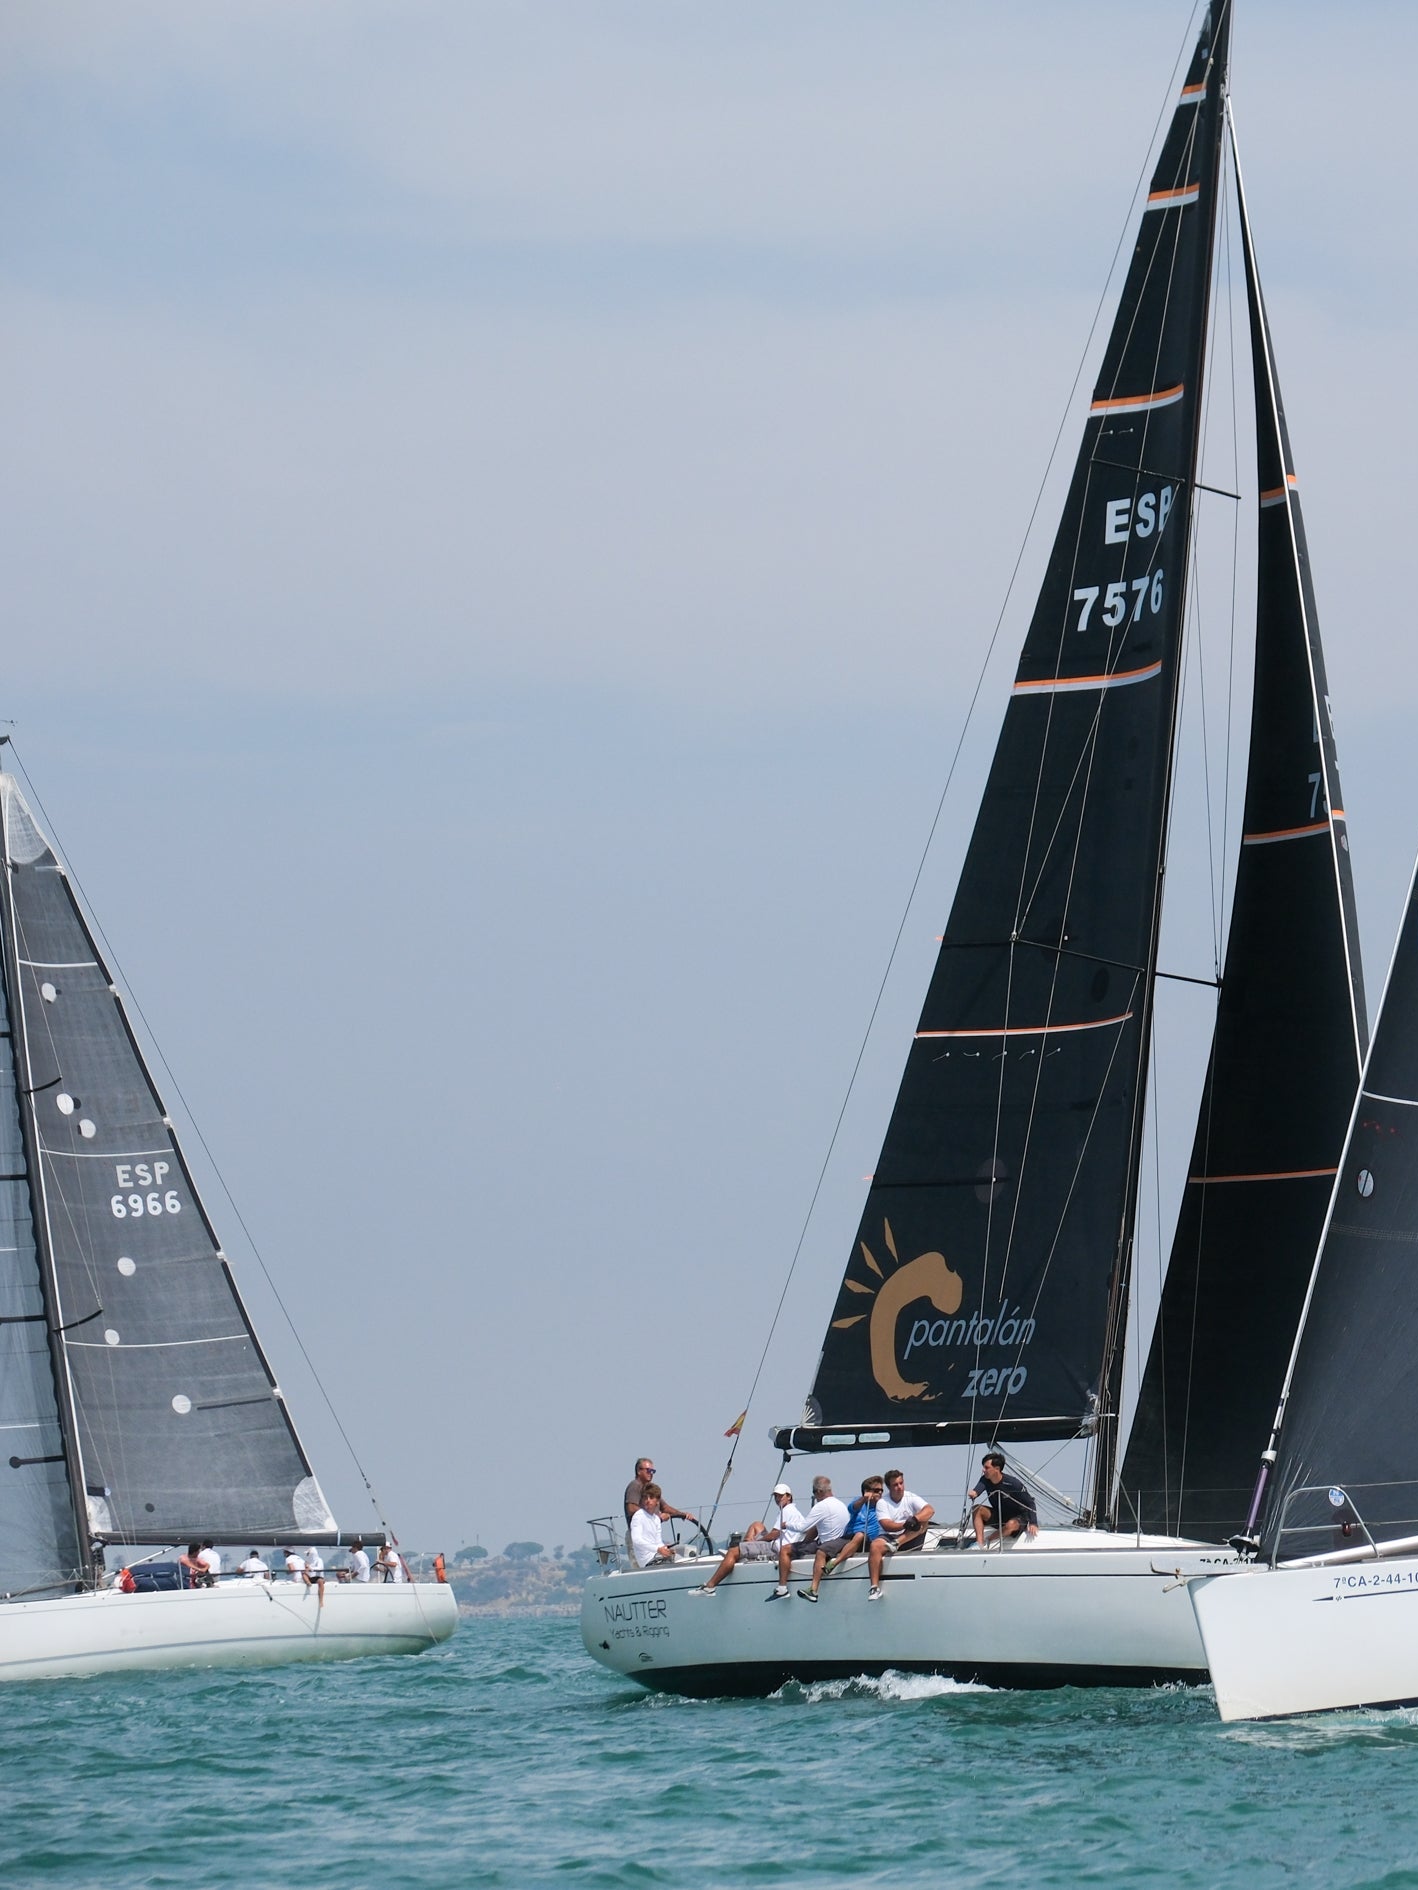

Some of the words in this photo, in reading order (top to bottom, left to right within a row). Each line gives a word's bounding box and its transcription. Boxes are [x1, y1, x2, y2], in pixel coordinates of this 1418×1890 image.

[1104, 485, 1172, 545] ESP
[1073, 568, 1165, 632] 7576
[115, 1161, 170, 1188] ESP
[110, 1190, 182, 1219] 6966
[903, 1298, 1037, 1360] pantalán
[961, 1366, 1028, 1398] zero
[604, 1599, 668, 1623] NAUTTER
